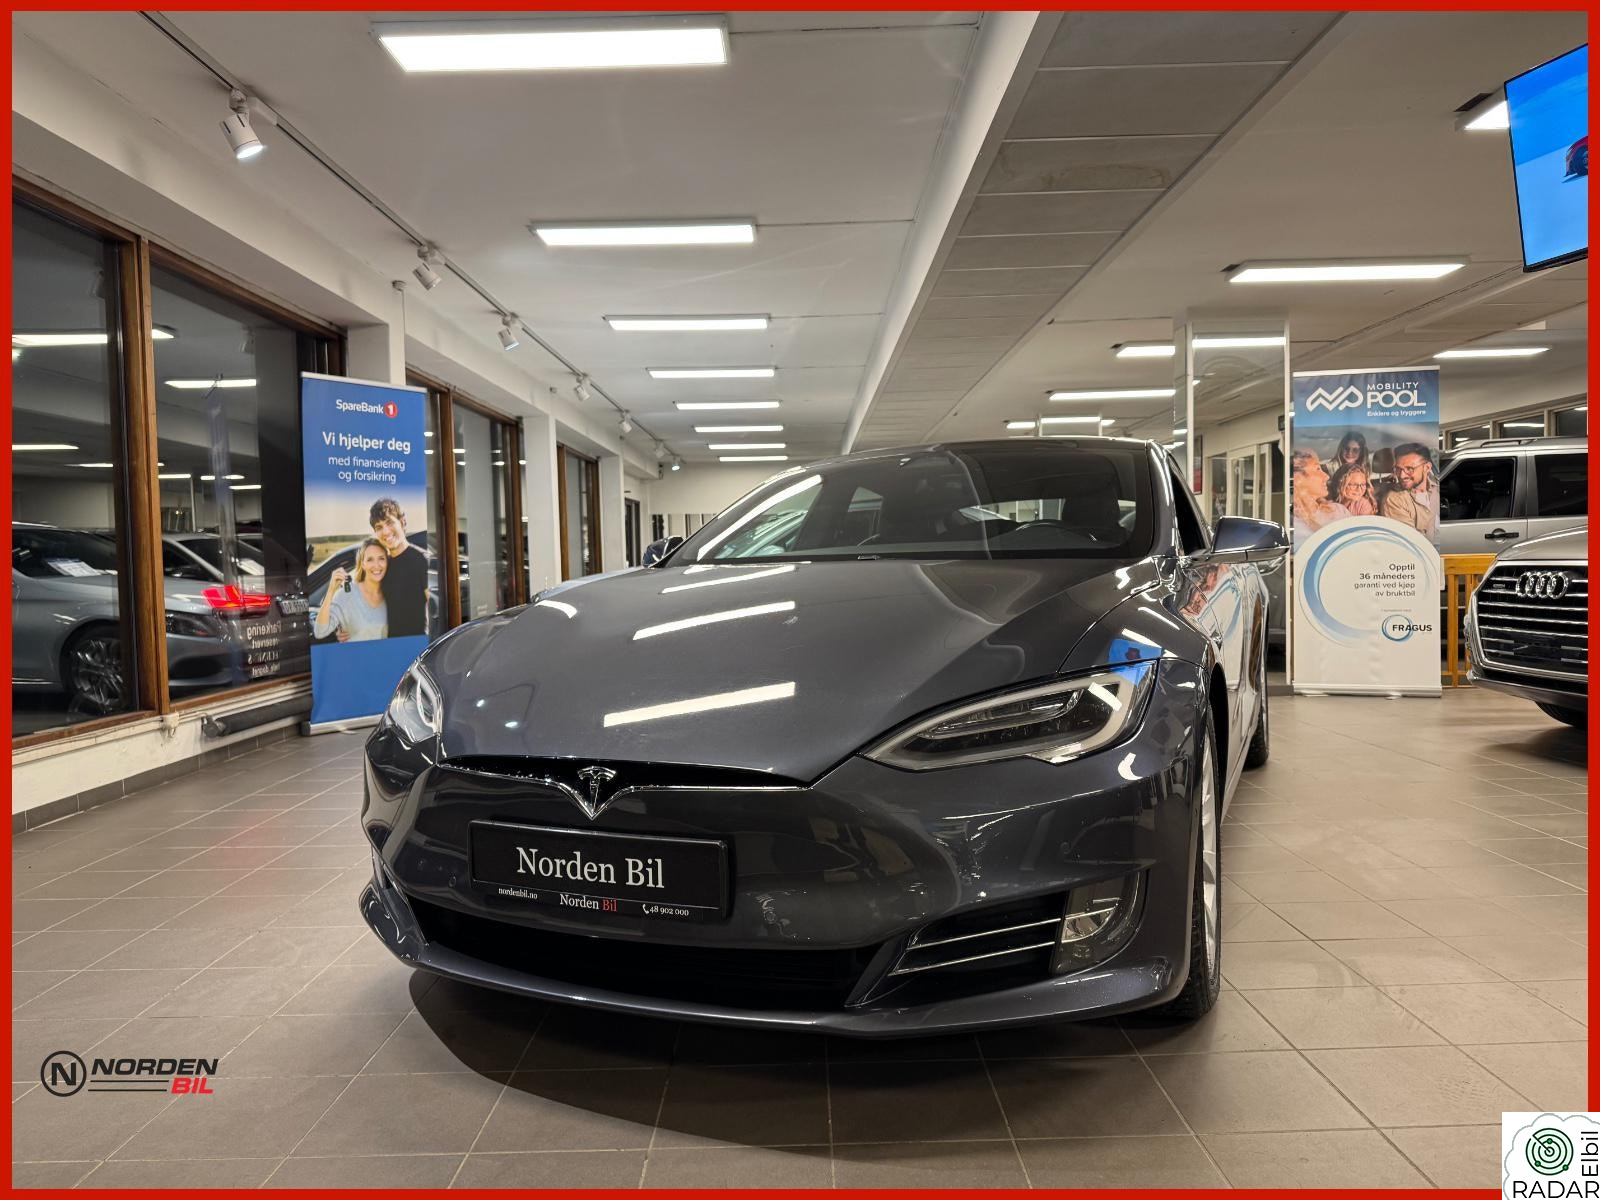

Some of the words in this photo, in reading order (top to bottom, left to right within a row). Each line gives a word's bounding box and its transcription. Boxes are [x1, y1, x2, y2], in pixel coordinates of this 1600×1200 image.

[1367, 381, 1419, 390] MOBILITY
[1367, 389, 1426, 408] POOL
[336, 399, 384, 414] SpareBank
[322, 431, 335, 446] Vi
[339, 432, 384, 451] hjelper
[387, 437, 411, 455] deg
[328, 456, 350, 466] med
[353, 456, 406, 472] finansiering
[338, 471, 352, 483] og
[354, 471, 397, 484] forsikring
[1389, 563, 1415, 572] Opptil
[1373, 572, 1415, 580] måneders
[1392, 624, 1433, 632] FRAGUS
[516, 846, 616, 884] Norden
[625, 857, 665, 888] Bil
[498, 887, 538, 899] nordenbil.no
[559, 893, 599, 910] Norden
[602, 897, 618, 912] Bil
[649, 905, 659, 914] 48
[659, 906, 673, 916] 902
[674, 907, 689, 917] 000
